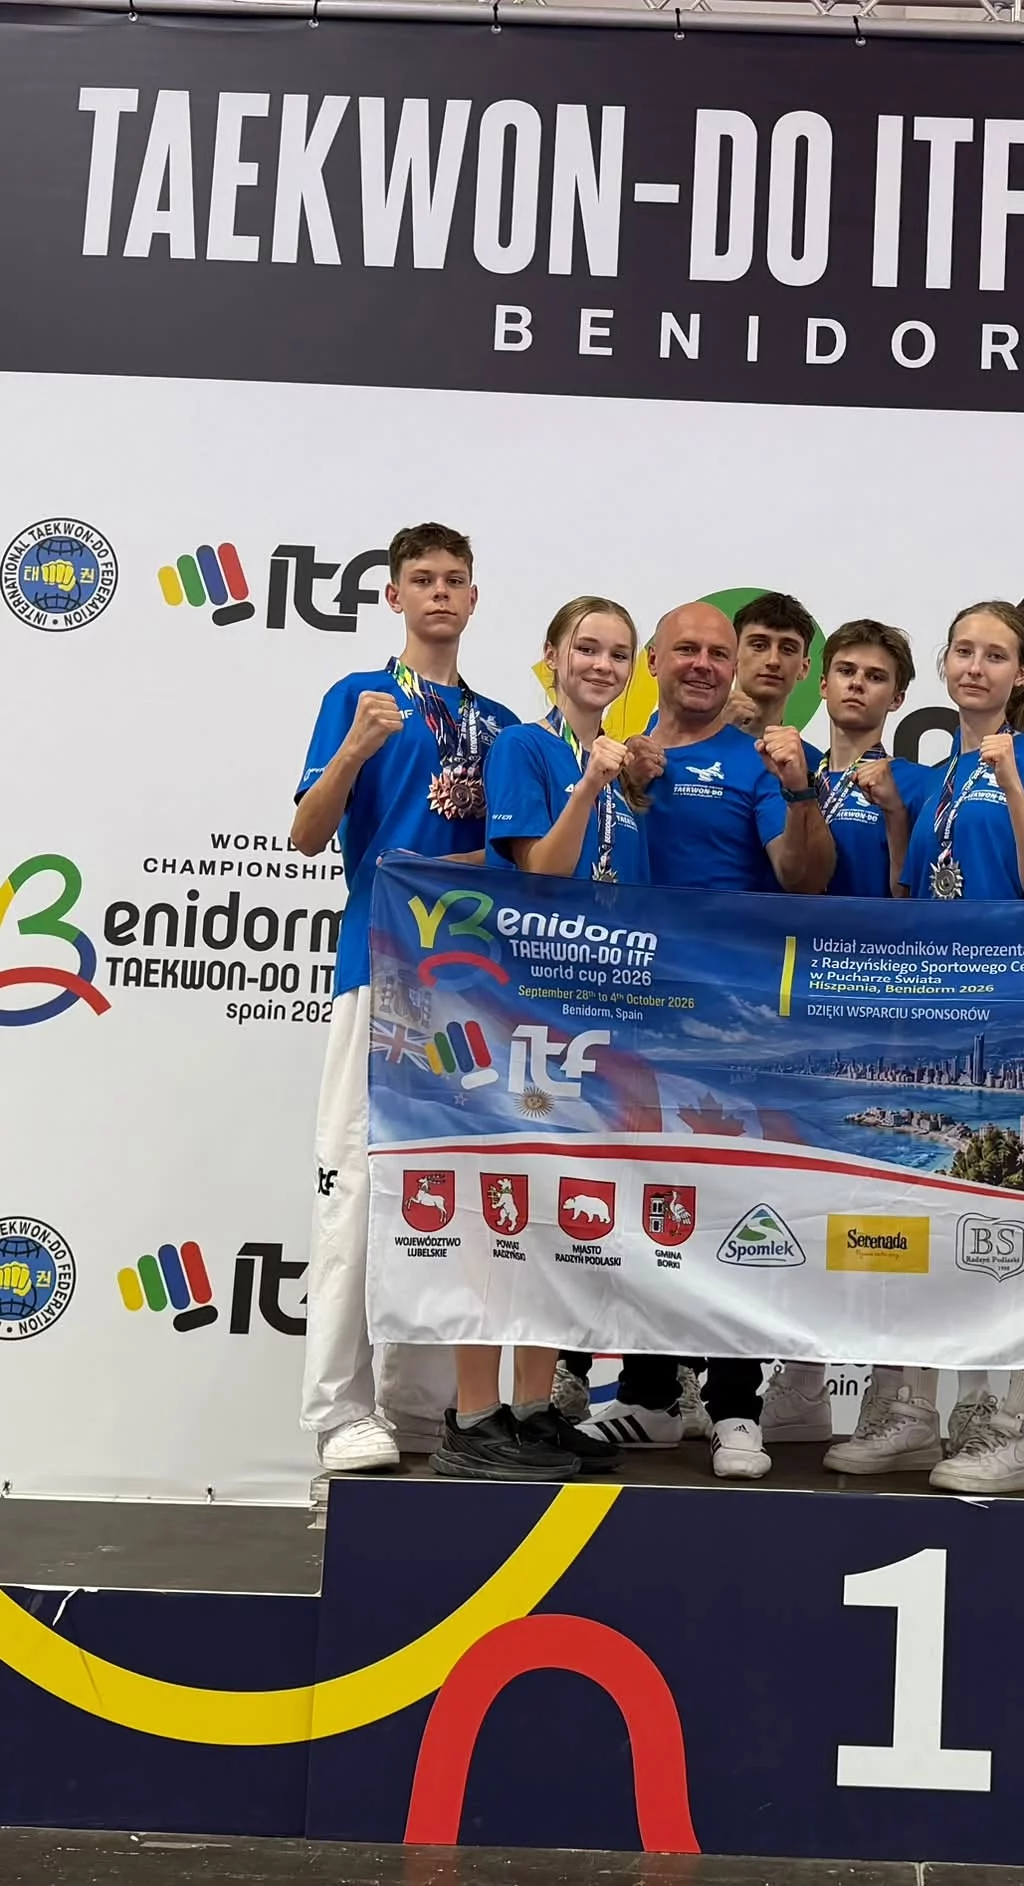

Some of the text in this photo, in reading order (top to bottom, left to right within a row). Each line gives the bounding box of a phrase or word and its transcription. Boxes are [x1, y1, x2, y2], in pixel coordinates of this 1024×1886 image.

[78, 86, 833, 287] TAEKWON-DO
[4, 522, 114, 627] INTERNATIONAL TAEKWON-DO FEDERATION
[143, 857, 344, 881] CHAMPIONSHIP
[509, 939, 655, 967] TAEKWON-DO ITF
[813, 937, 856, 954] Udział
[860, 941, 949, 956] zawodników
[106, 956, 334, 994] TAEKWON-DO IT
[530, 964, 652, 986] world cup 2026
[811, 959, 818, 968] z
[822, 957, 918, 975] Radzyńskiego
[921, 960, 1007, 975] Sportowego
[810, 972, 824, 980] w
[827, 971, 891, 983] Pucharze
[518, 984, 573, 1000] September
[626, 993, 665, 1007] October
[668, 996, 695, 1009] 2026
[885, 984, 955, 994] Benidorm
[959, 984, 995, 993] 2026
[226, 1000, 333, 1025] spain 202
[615, 1008, 644, 1022] Spain
[807, 1004, 990, 1021] DZIĘKI WSPARCIU SPONSORÓW
[395, 1235, 461, 1247] WOJEWÓDZTWO
[572, 1245, 602, 1255] MIASTO
[847, 1229, 908, 1250] Serenada
[970, 1228, 1015, 1256] BS
[407, 1248, 448, 1258] LUBELSKIE
[655, 1249, 682, 1260] GMINA
[725, 1239, 795, 1262] Spomlek
[585, 1256, 622, 1267] PODLASKI
[657, 1258, 681, 1269] BORKI
[18, 1263, 71, 1336] FEDERATION
[837, 1548, 992, 1792] 1
